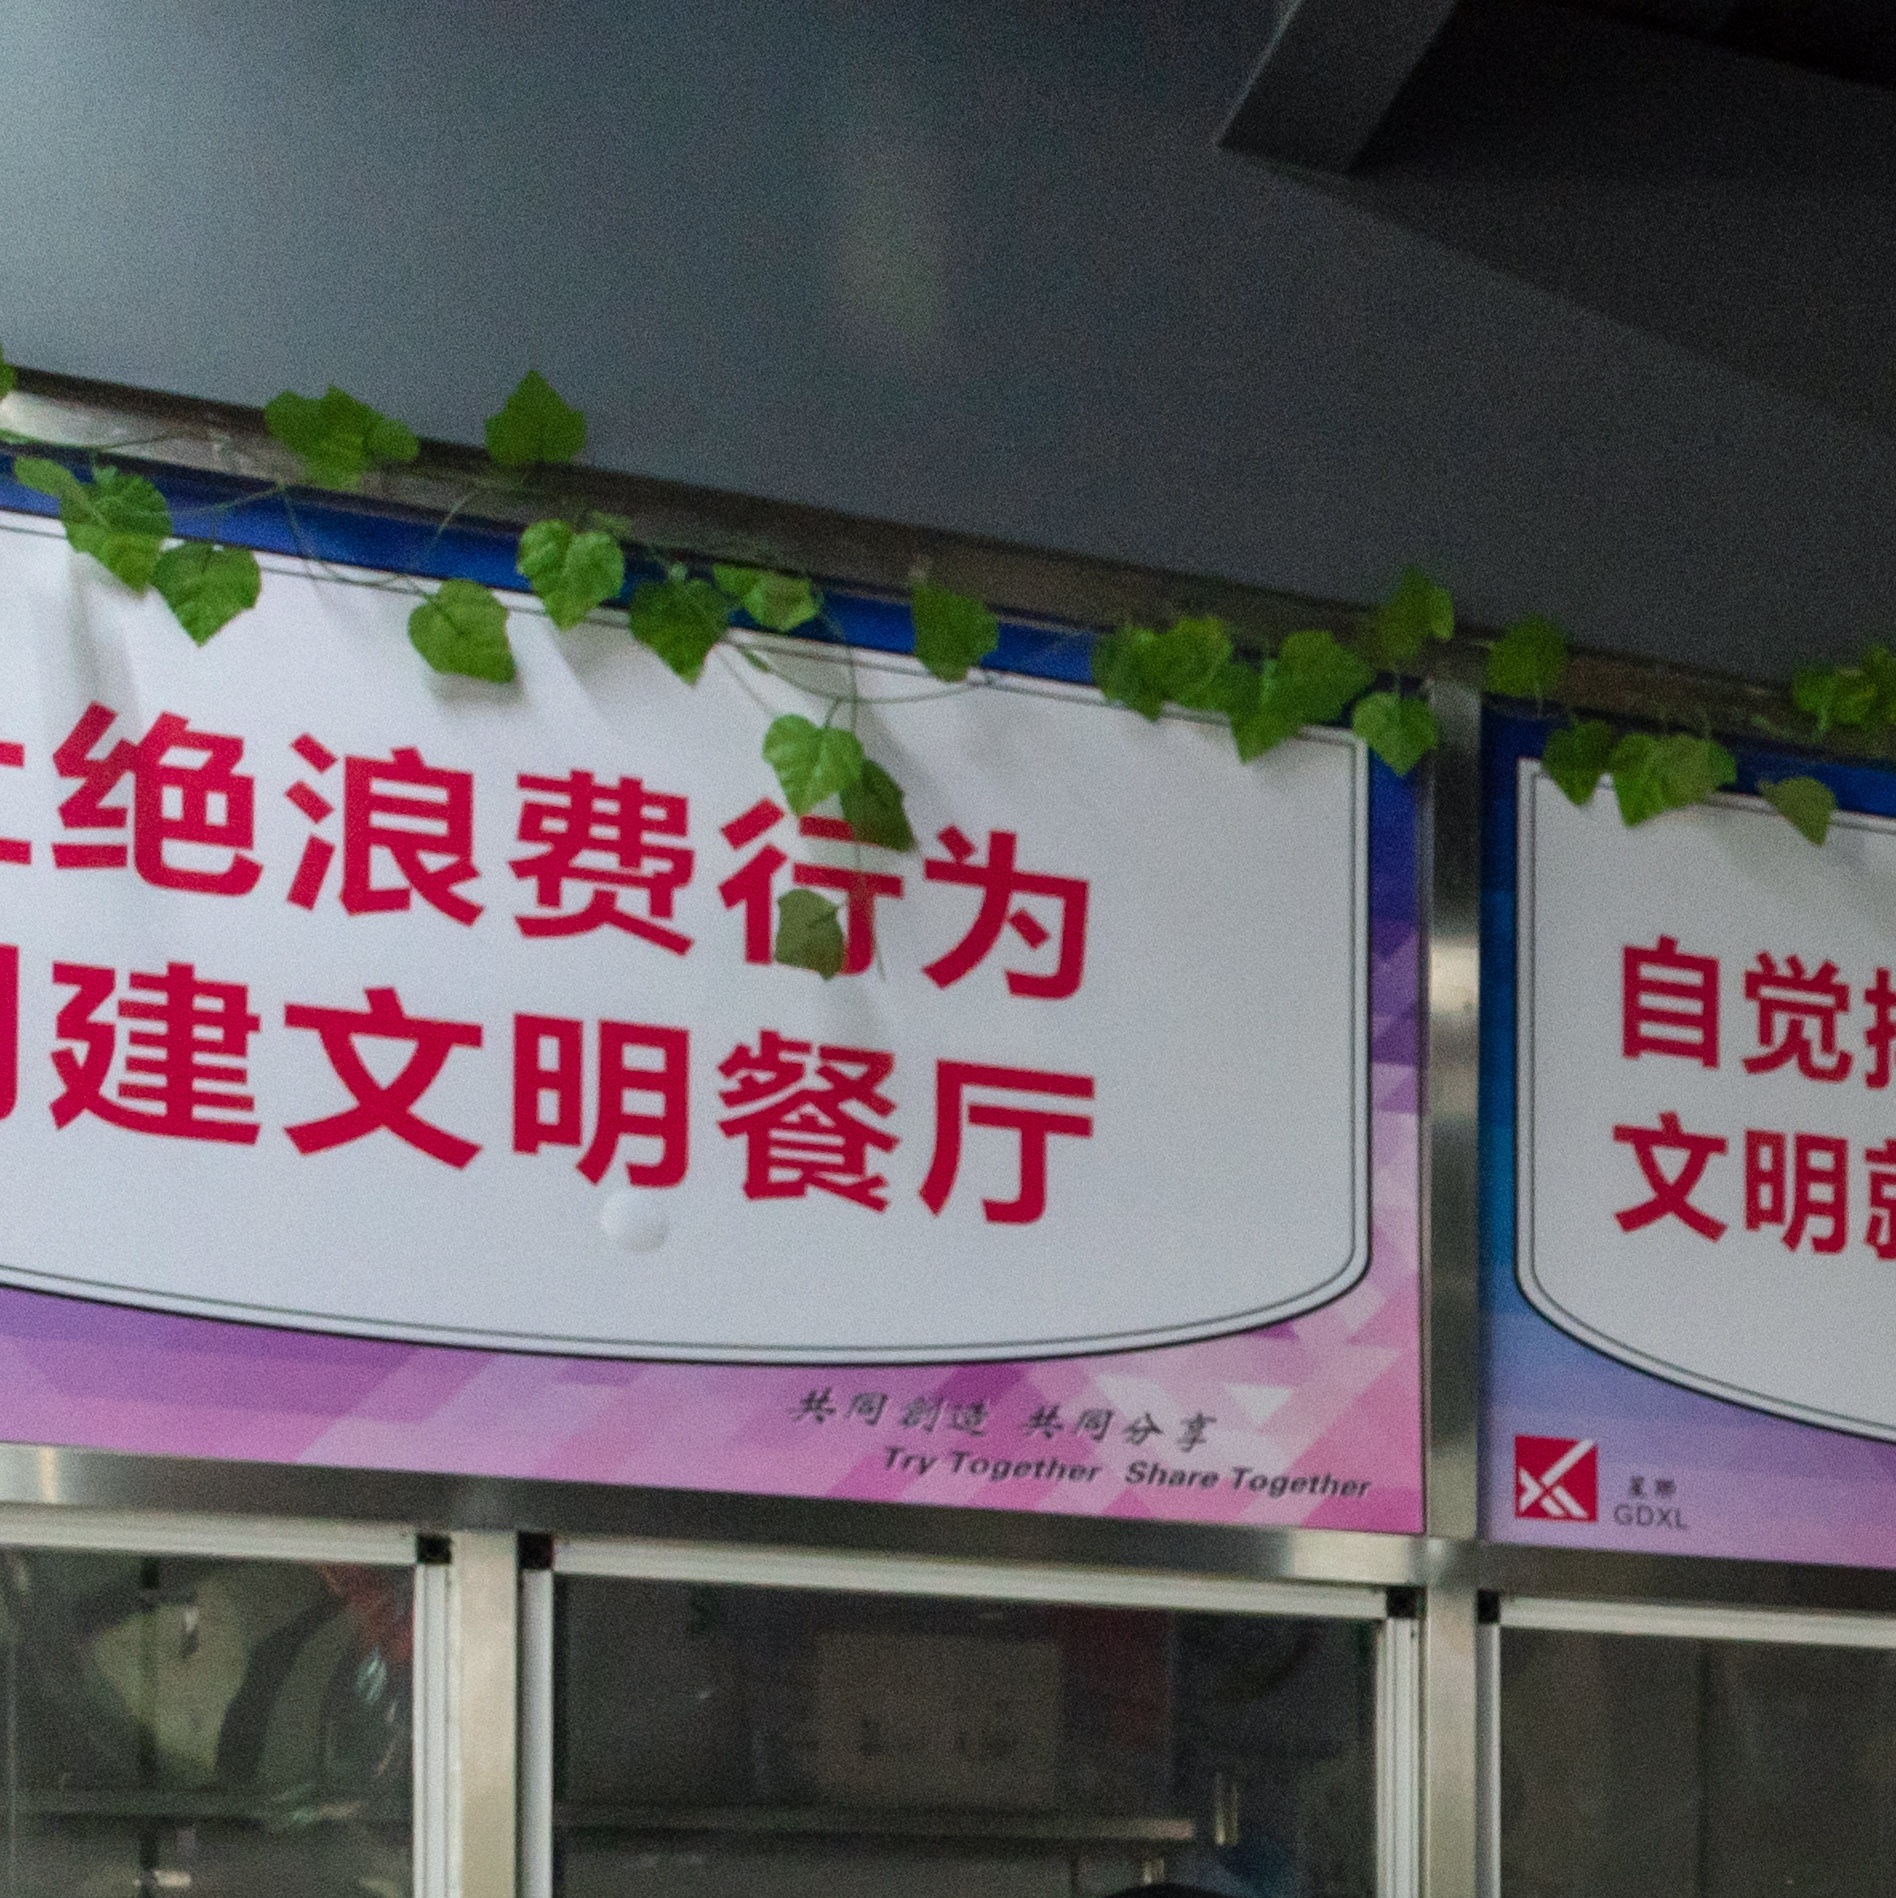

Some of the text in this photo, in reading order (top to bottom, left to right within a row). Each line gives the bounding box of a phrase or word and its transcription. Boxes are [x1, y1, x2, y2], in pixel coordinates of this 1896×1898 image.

[883, 1446, 1372, 1500] Try Together Share Together
[1612, 1503, 1690, 1531] GDXL
